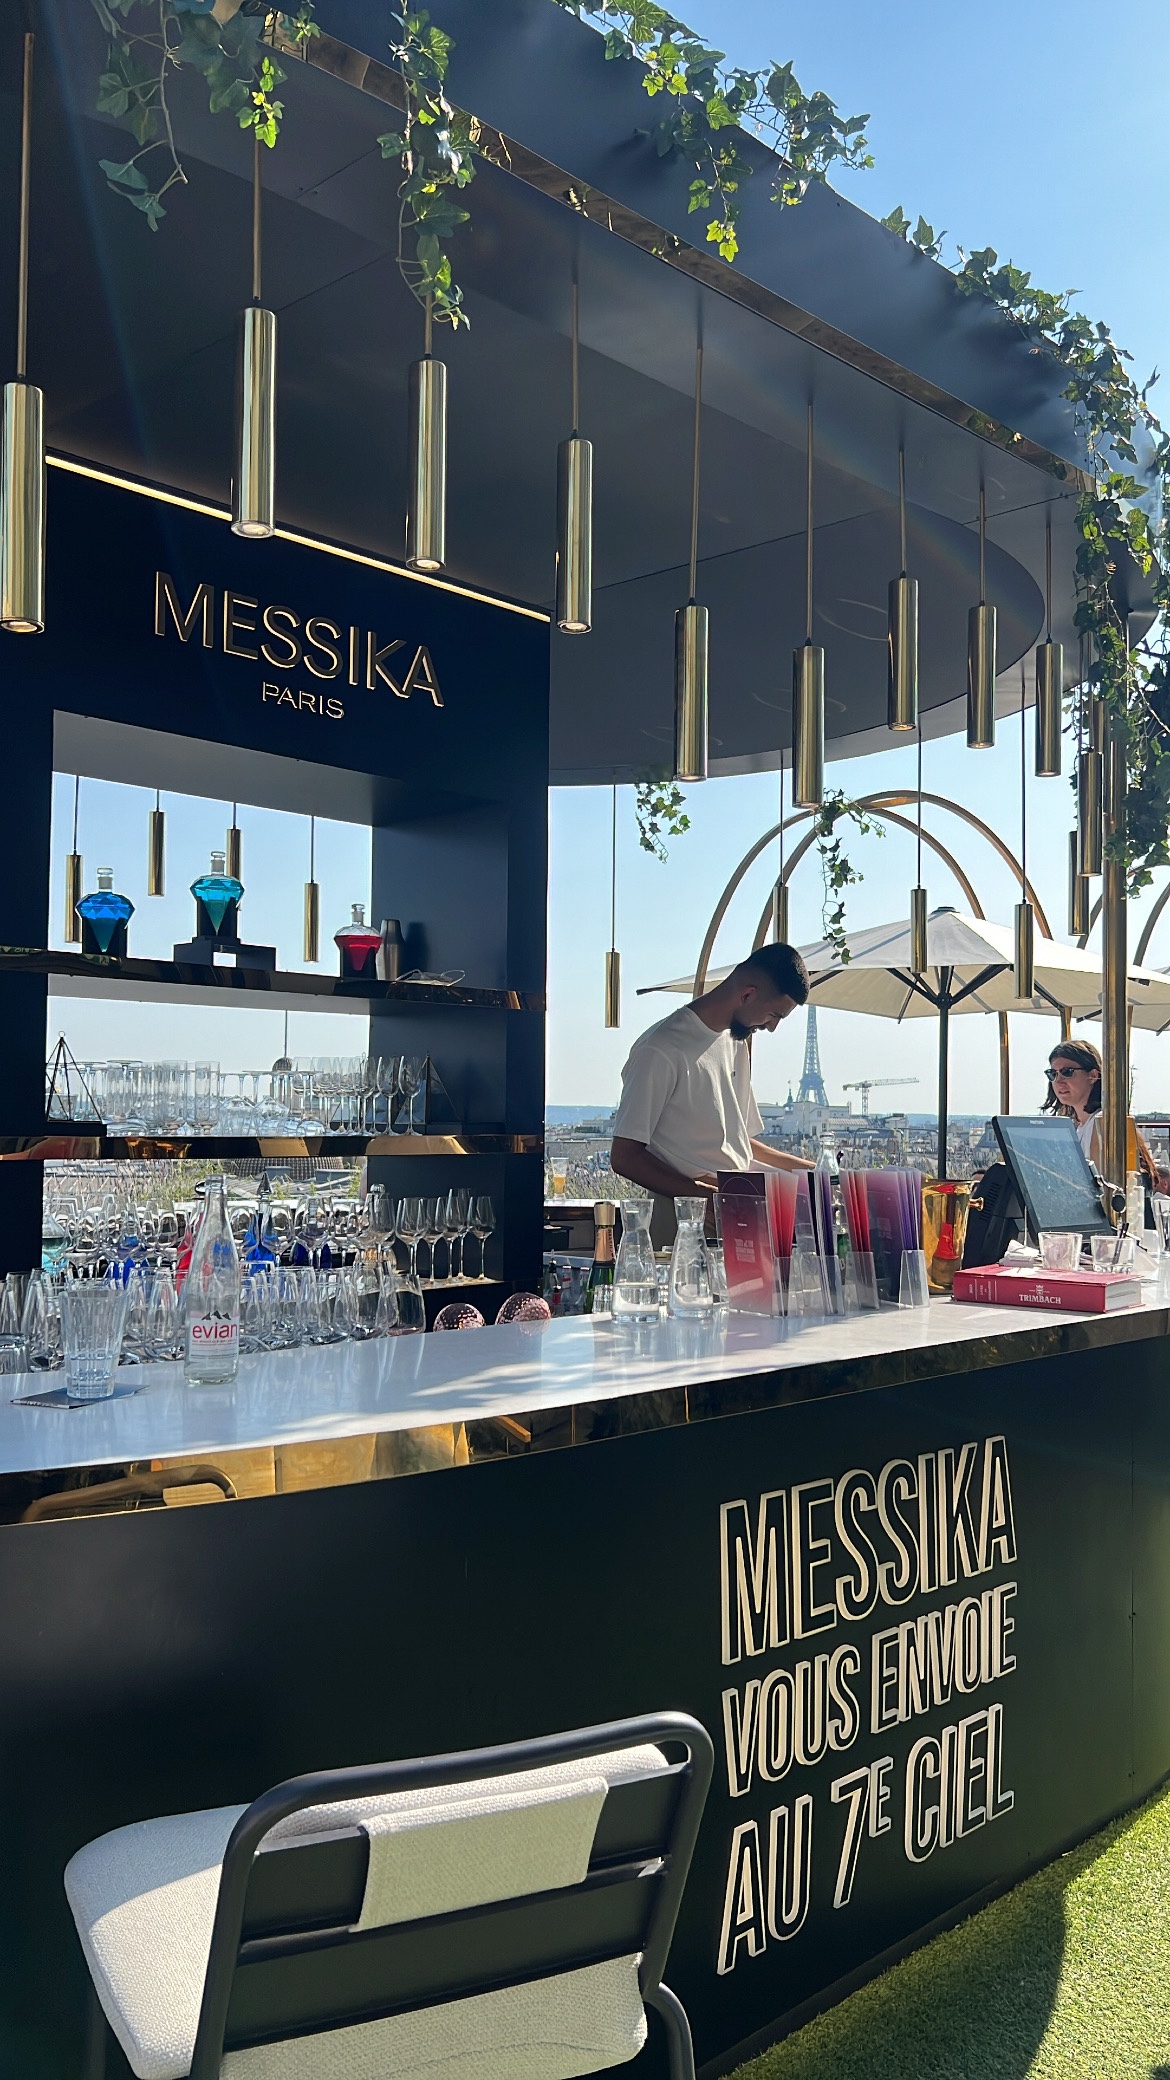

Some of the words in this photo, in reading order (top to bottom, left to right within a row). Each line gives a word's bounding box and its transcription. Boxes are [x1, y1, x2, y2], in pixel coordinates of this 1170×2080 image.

[154, 570, 446, 707] MESSIKA
[261, 681, 345, 719] PARIS
[192, 1322, 238, 1339] evian
[1019, 1293, 1061, 1304] TRIMBACH
[719, 1435, 1018, 1665] MESSIKA
[721, 1644, 860, 1798] VOUS
[870, 1582, 1018, 1734] ENVOIE
[717, 1794, 813, 1976] AU
[904, 1703, 1015, 1863] CIEL
